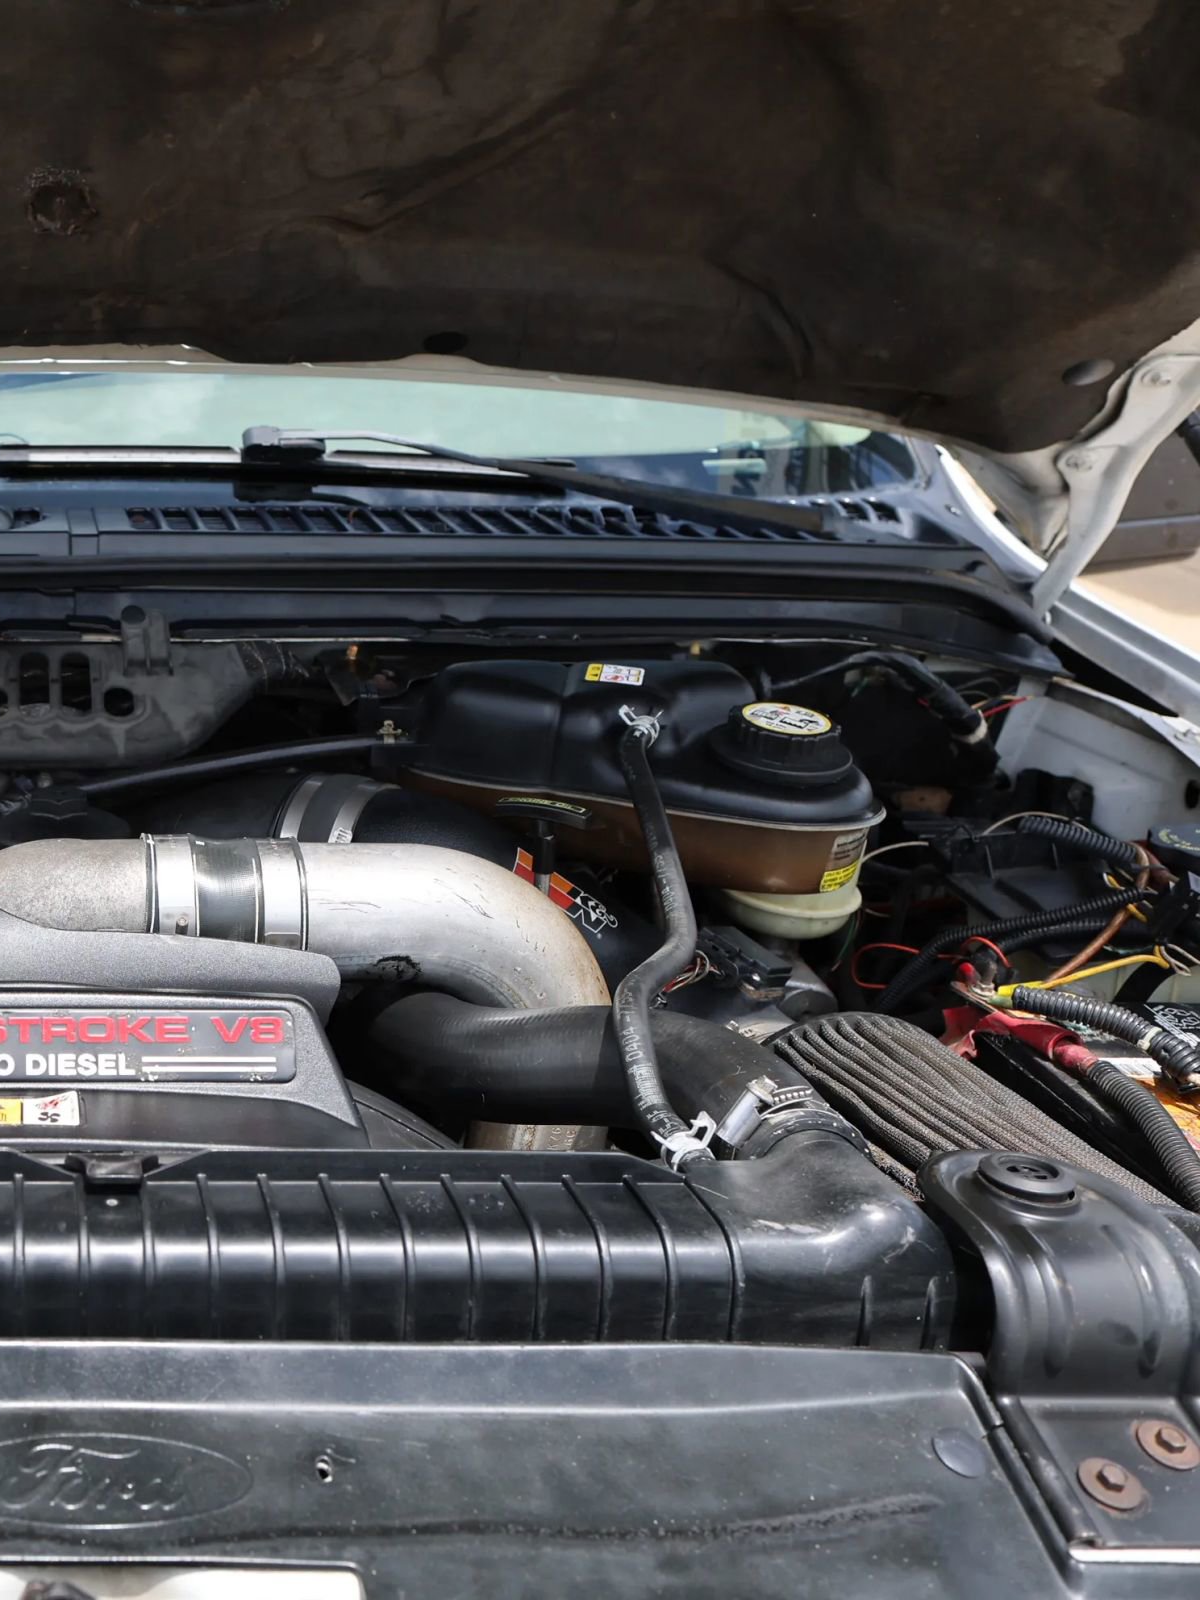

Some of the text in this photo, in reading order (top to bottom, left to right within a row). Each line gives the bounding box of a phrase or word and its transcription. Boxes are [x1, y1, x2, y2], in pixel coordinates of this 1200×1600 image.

[211, 1016, 285, 1044] V8
[25, 1053, 136, 1076] DIESEL
[0, 1442, 192, 1511] Ford
